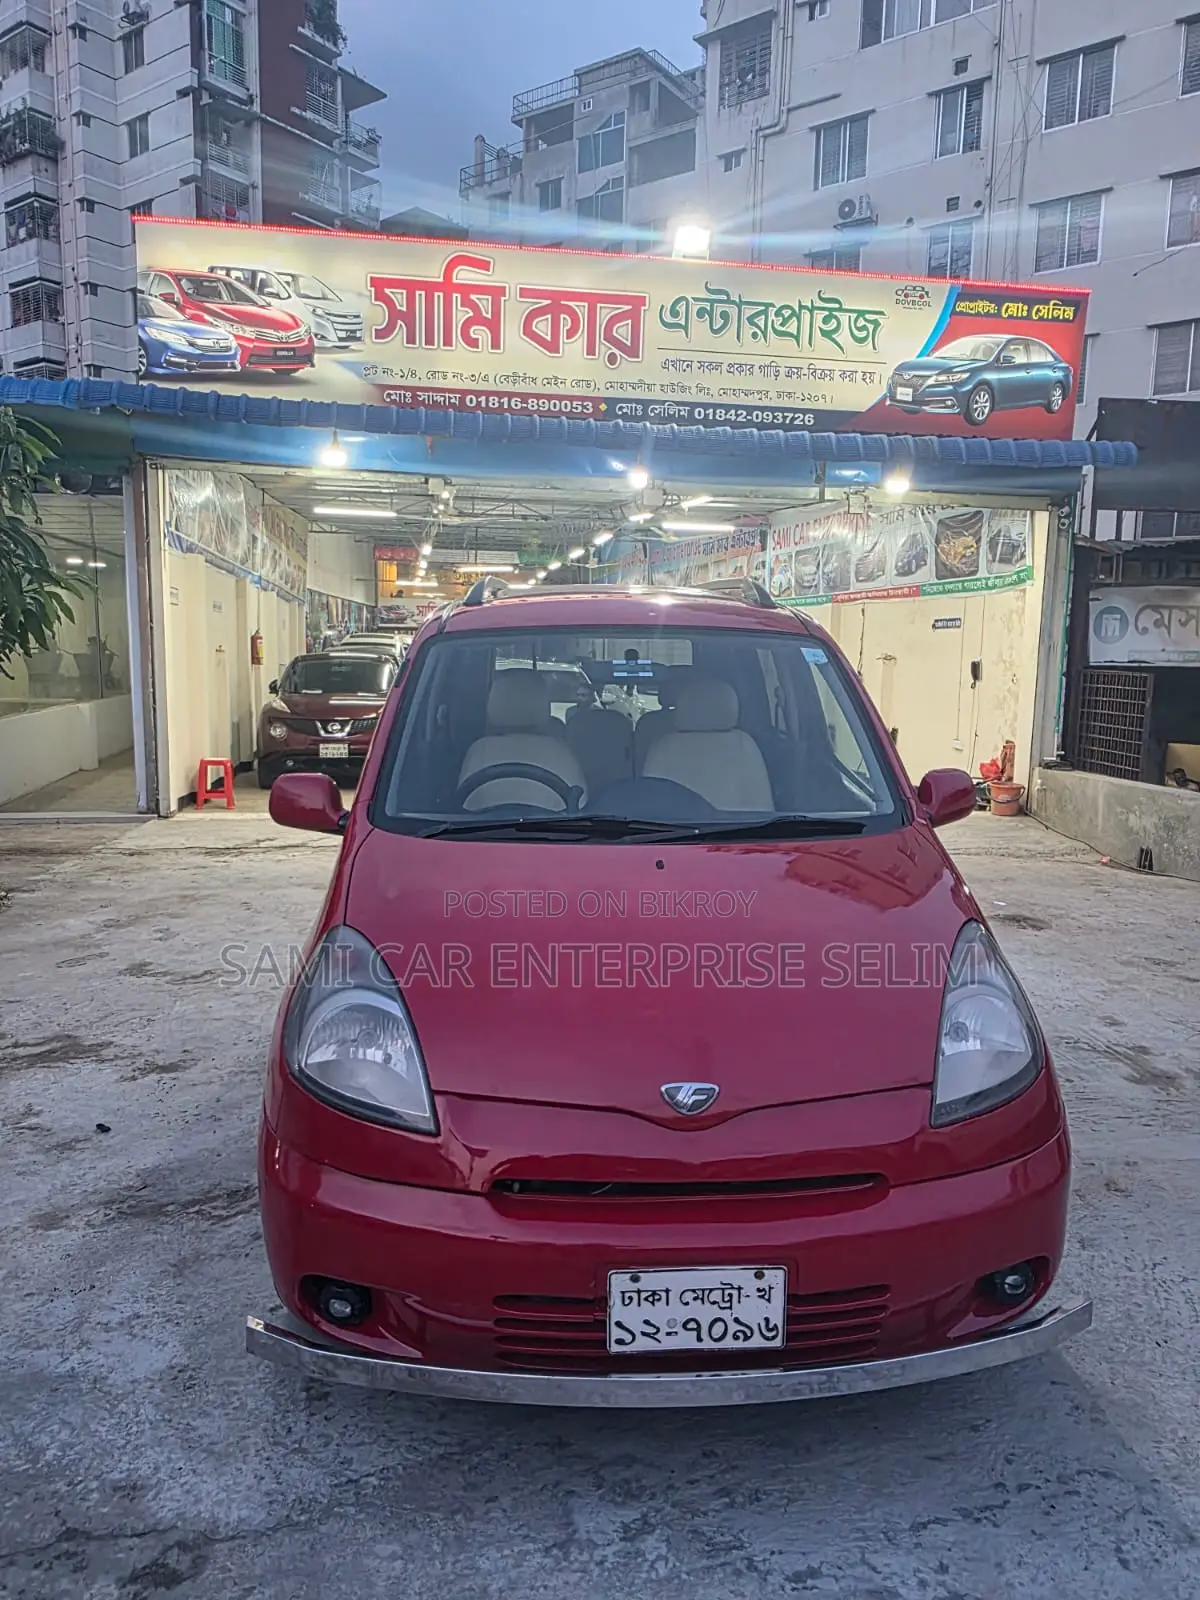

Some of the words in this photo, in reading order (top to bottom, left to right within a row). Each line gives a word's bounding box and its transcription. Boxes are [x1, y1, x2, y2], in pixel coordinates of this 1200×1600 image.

[368, 252, 509, 353] সামি
[516, 285, 650, 369] কার
[658, 280, 887, 356] এন্টারপ্রাইজ
[1001, 301, 1028, 318] মোঃ
[1032, 300, 1075, 320] সেলিম
[425, 369, 449, 381] রোড
[541, 375, 567, 389] মেইন
[661, 357, 694, 374] এখানে
[696, 360, 724, 376] সকল
[726, 362, 756, 377] প্রকার
[758, 361, 781, 381] গাড়ি
[838, 369, 859, 384] করা
[383, 389, 413, 404] মোঃ
[464, 394, 594, 414] 01816-890053
[615, 402, 644, 417] মোঃ
[647, 401, 690, 419] সেলিম
[693, 407, 815, 426] 01842-093726
[620, 1287, 672, 1308] ঢাকা
[613, 1315, 780, 1346] ১২-৭০৯৬
